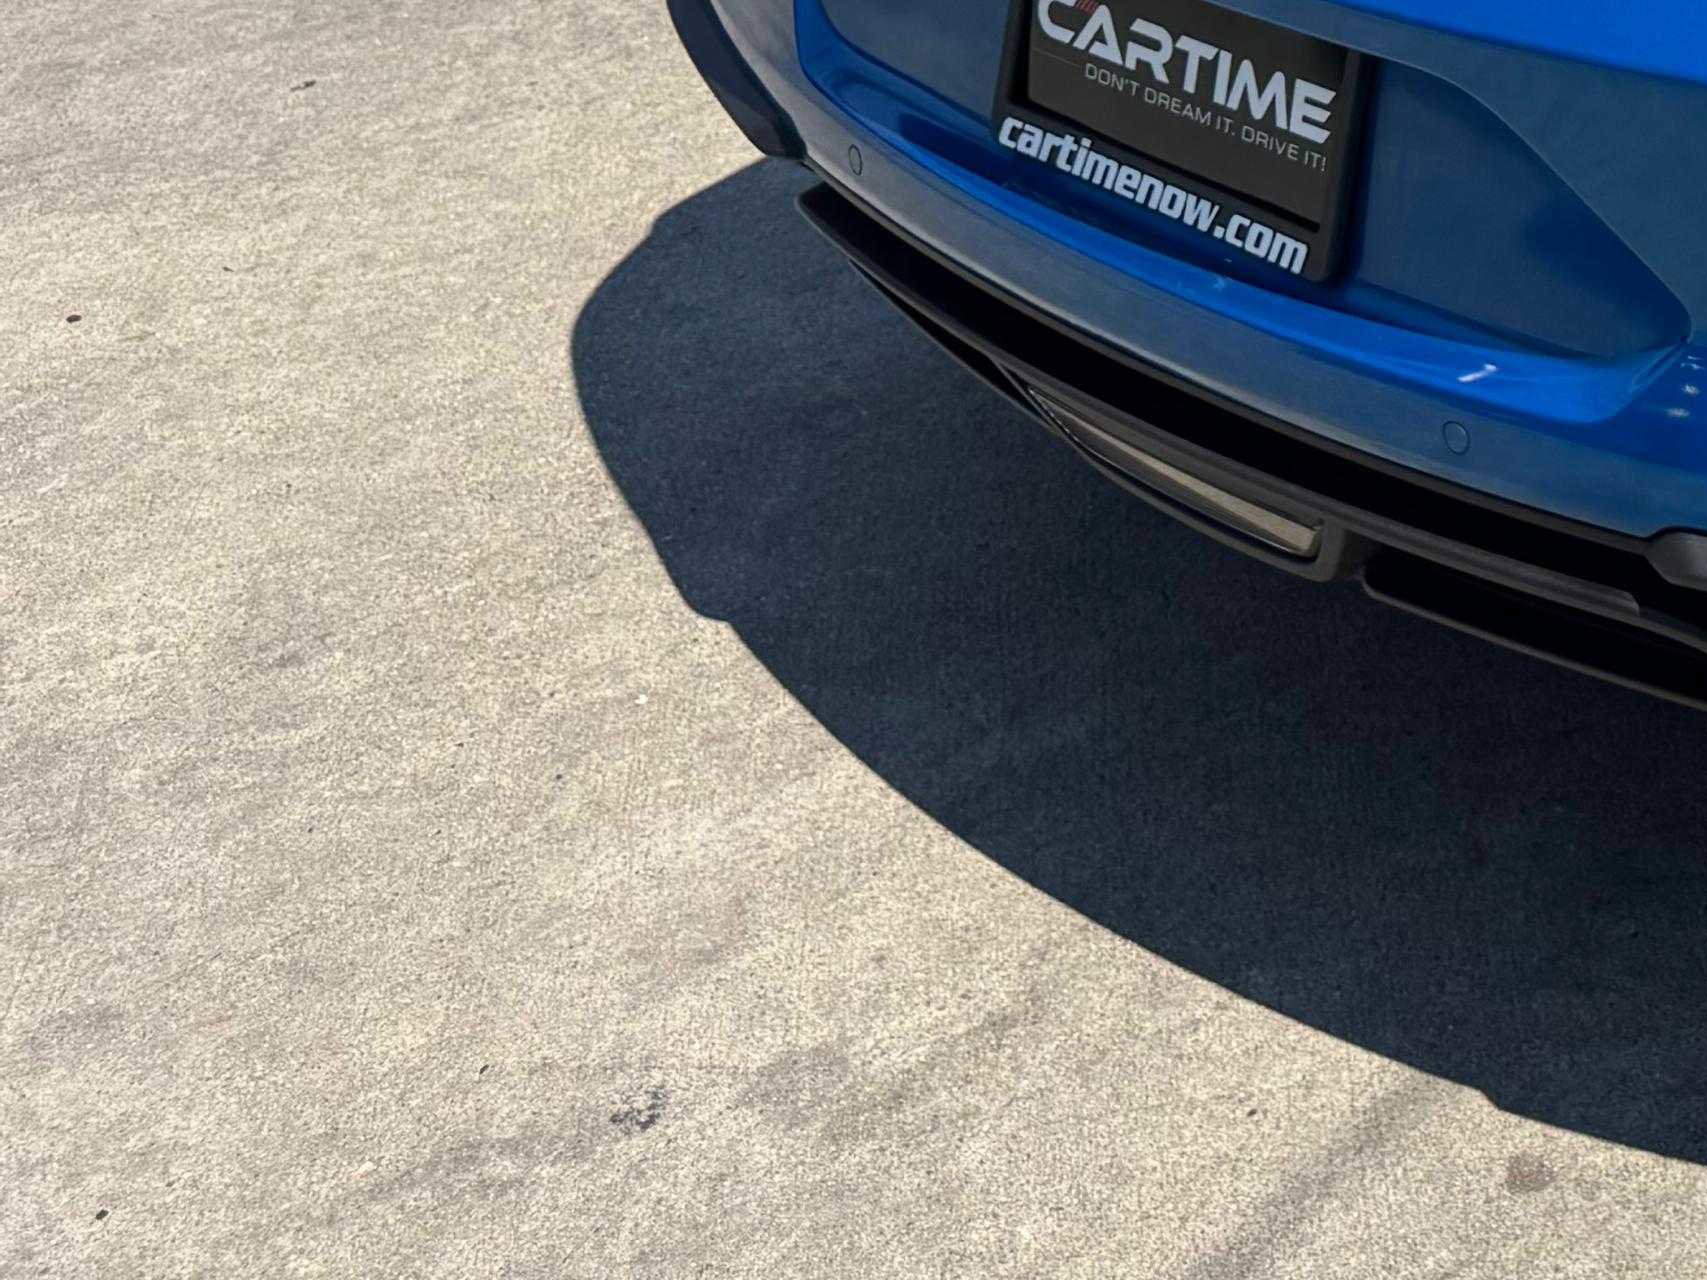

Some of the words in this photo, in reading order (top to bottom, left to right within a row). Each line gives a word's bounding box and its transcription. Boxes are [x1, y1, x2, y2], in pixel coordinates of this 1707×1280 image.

[1085, 61, 1141, 97] DON'T
[1144, 87, 1212, 127] DREAM
[1215, 114, 1236, 138] IT.
[1242, 125, 1299, 160] DRIVE
[1303, 150, 1328, 172] IT!
[999, 117, 1309, 274] cartimenow.com
